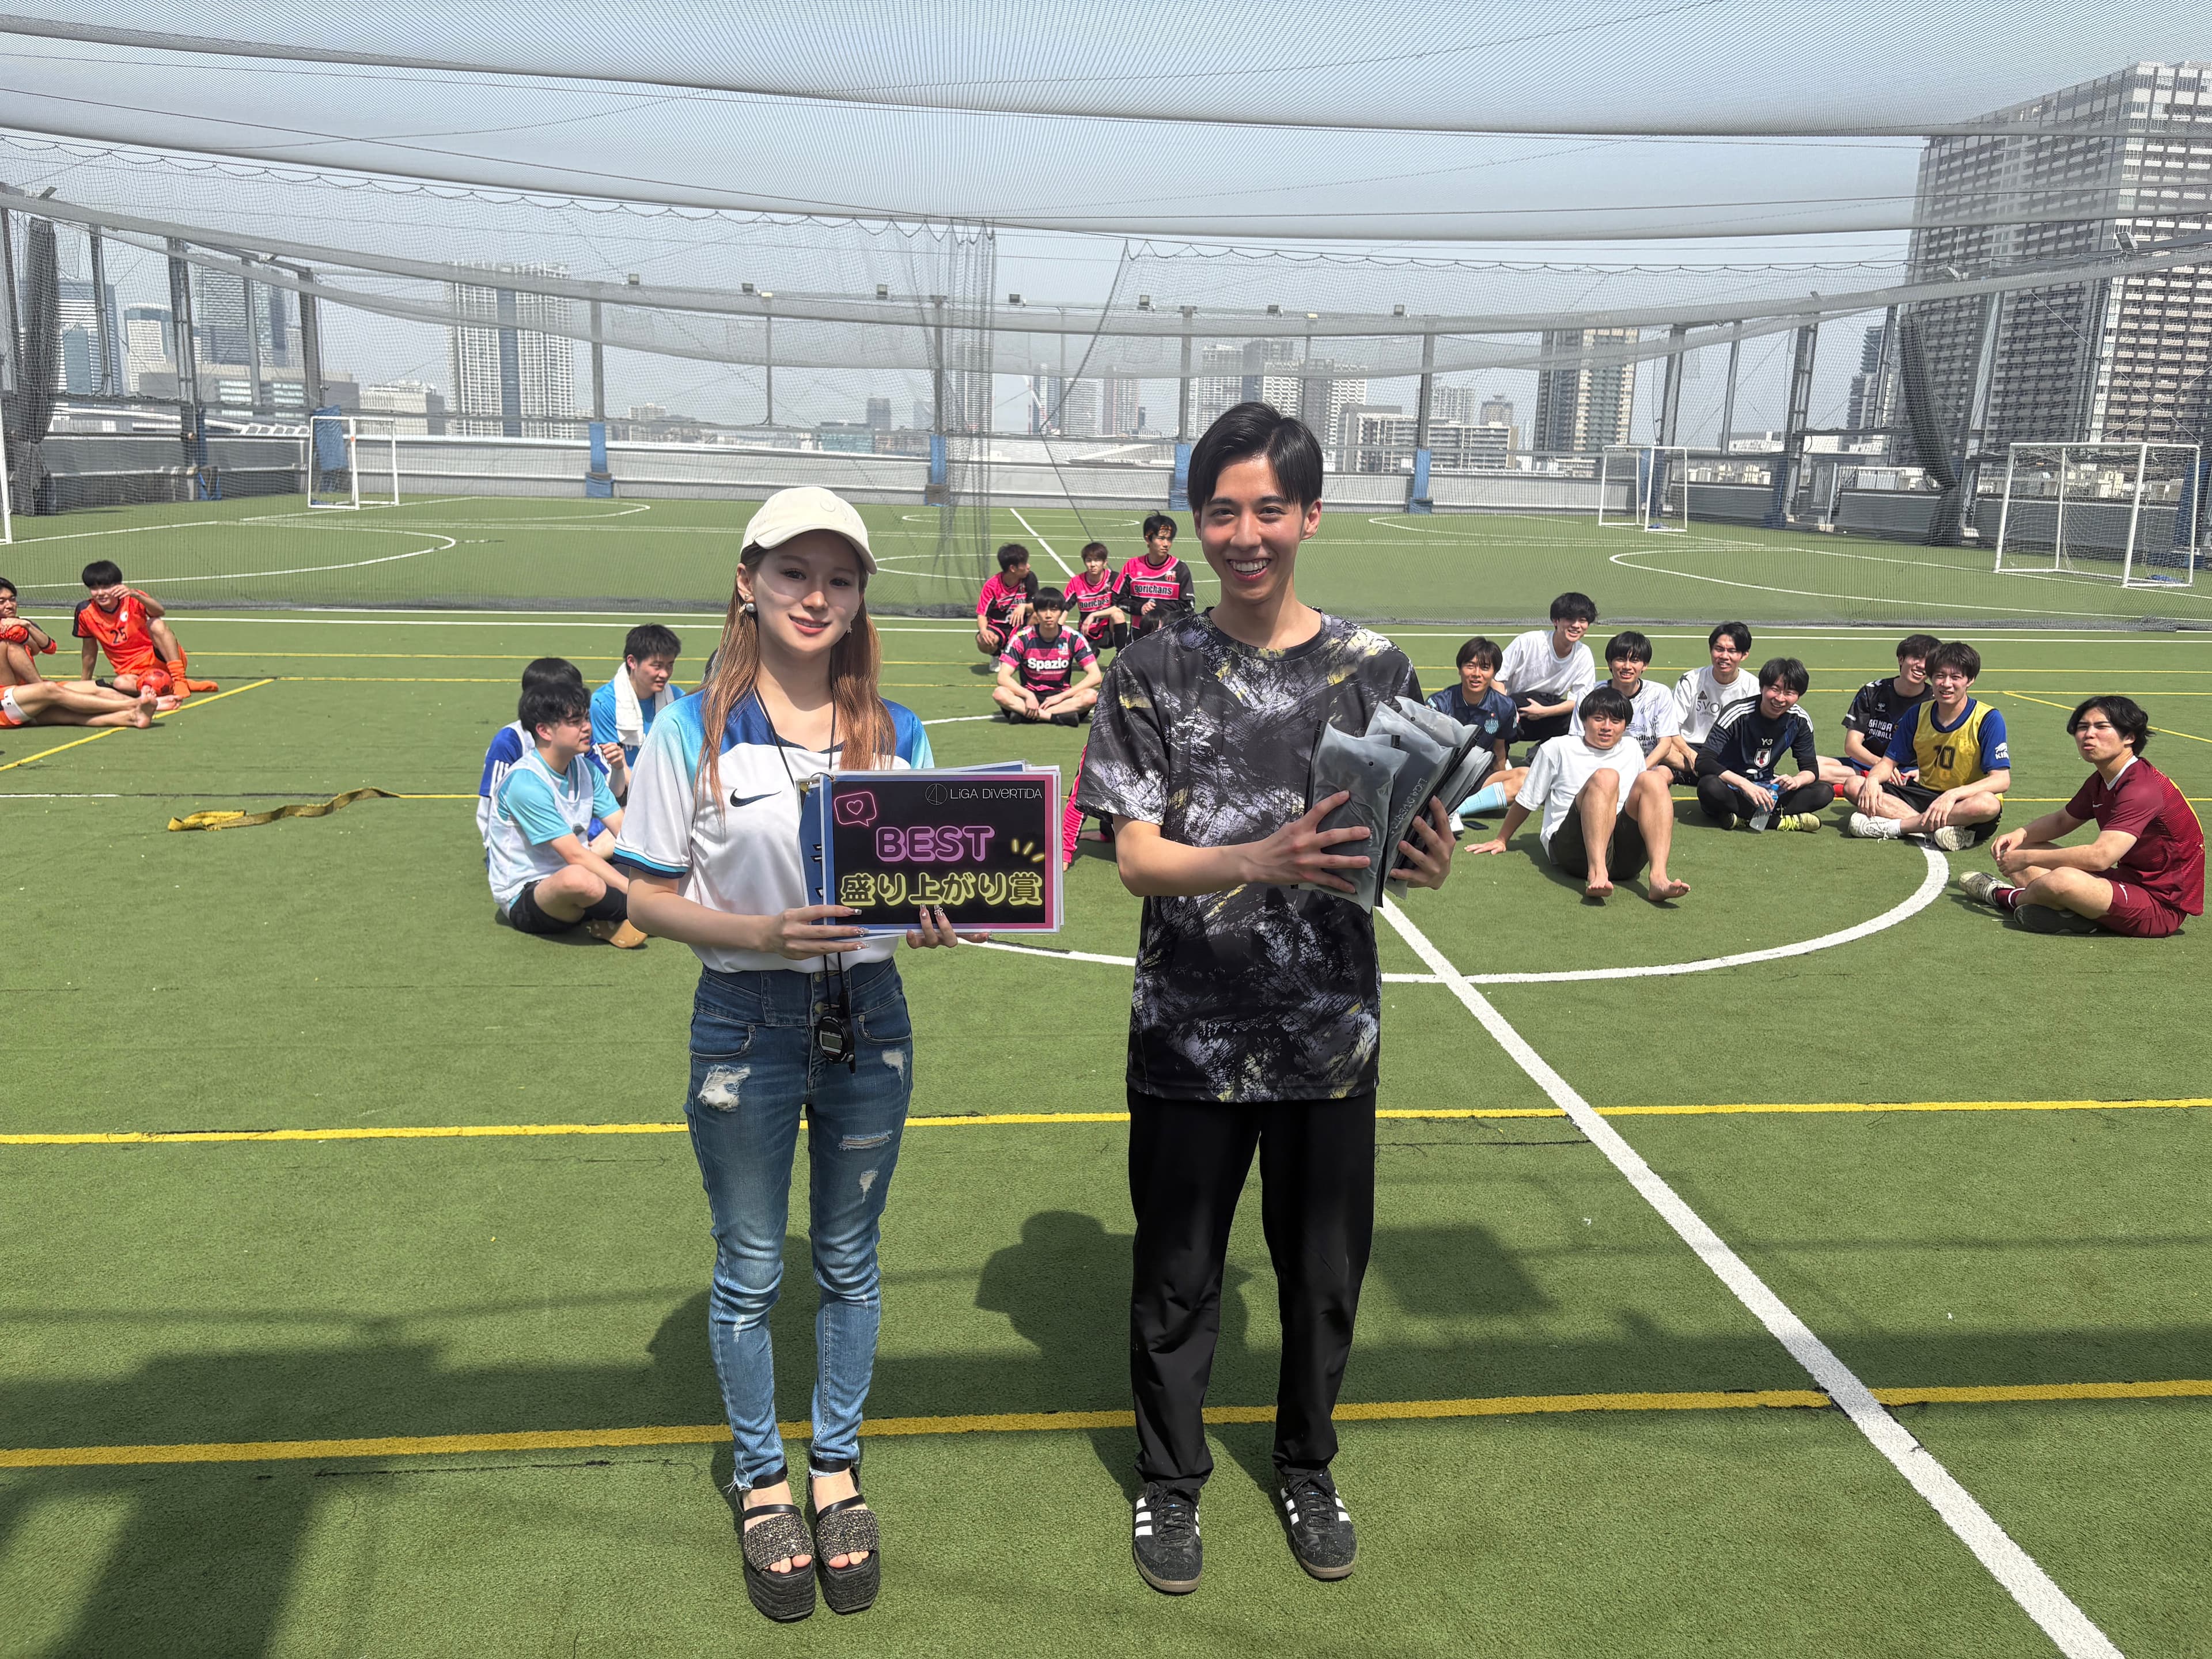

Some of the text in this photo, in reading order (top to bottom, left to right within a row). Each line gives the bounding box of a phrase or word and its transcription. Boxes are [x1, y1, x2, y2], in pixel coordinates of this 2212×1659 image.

[110, 626, 127, 644] 25
[1028, 657, 1069, 672] Spazio
[1868, 719, 1893, 732] GAMBA
[1868, 728, 1892, 740] OOTBALL
[1933, 745, 1956, 770] 10
[876, 825, 995, 862] BEST
[840, 871, 1043, 907] 盛り上がり賞
